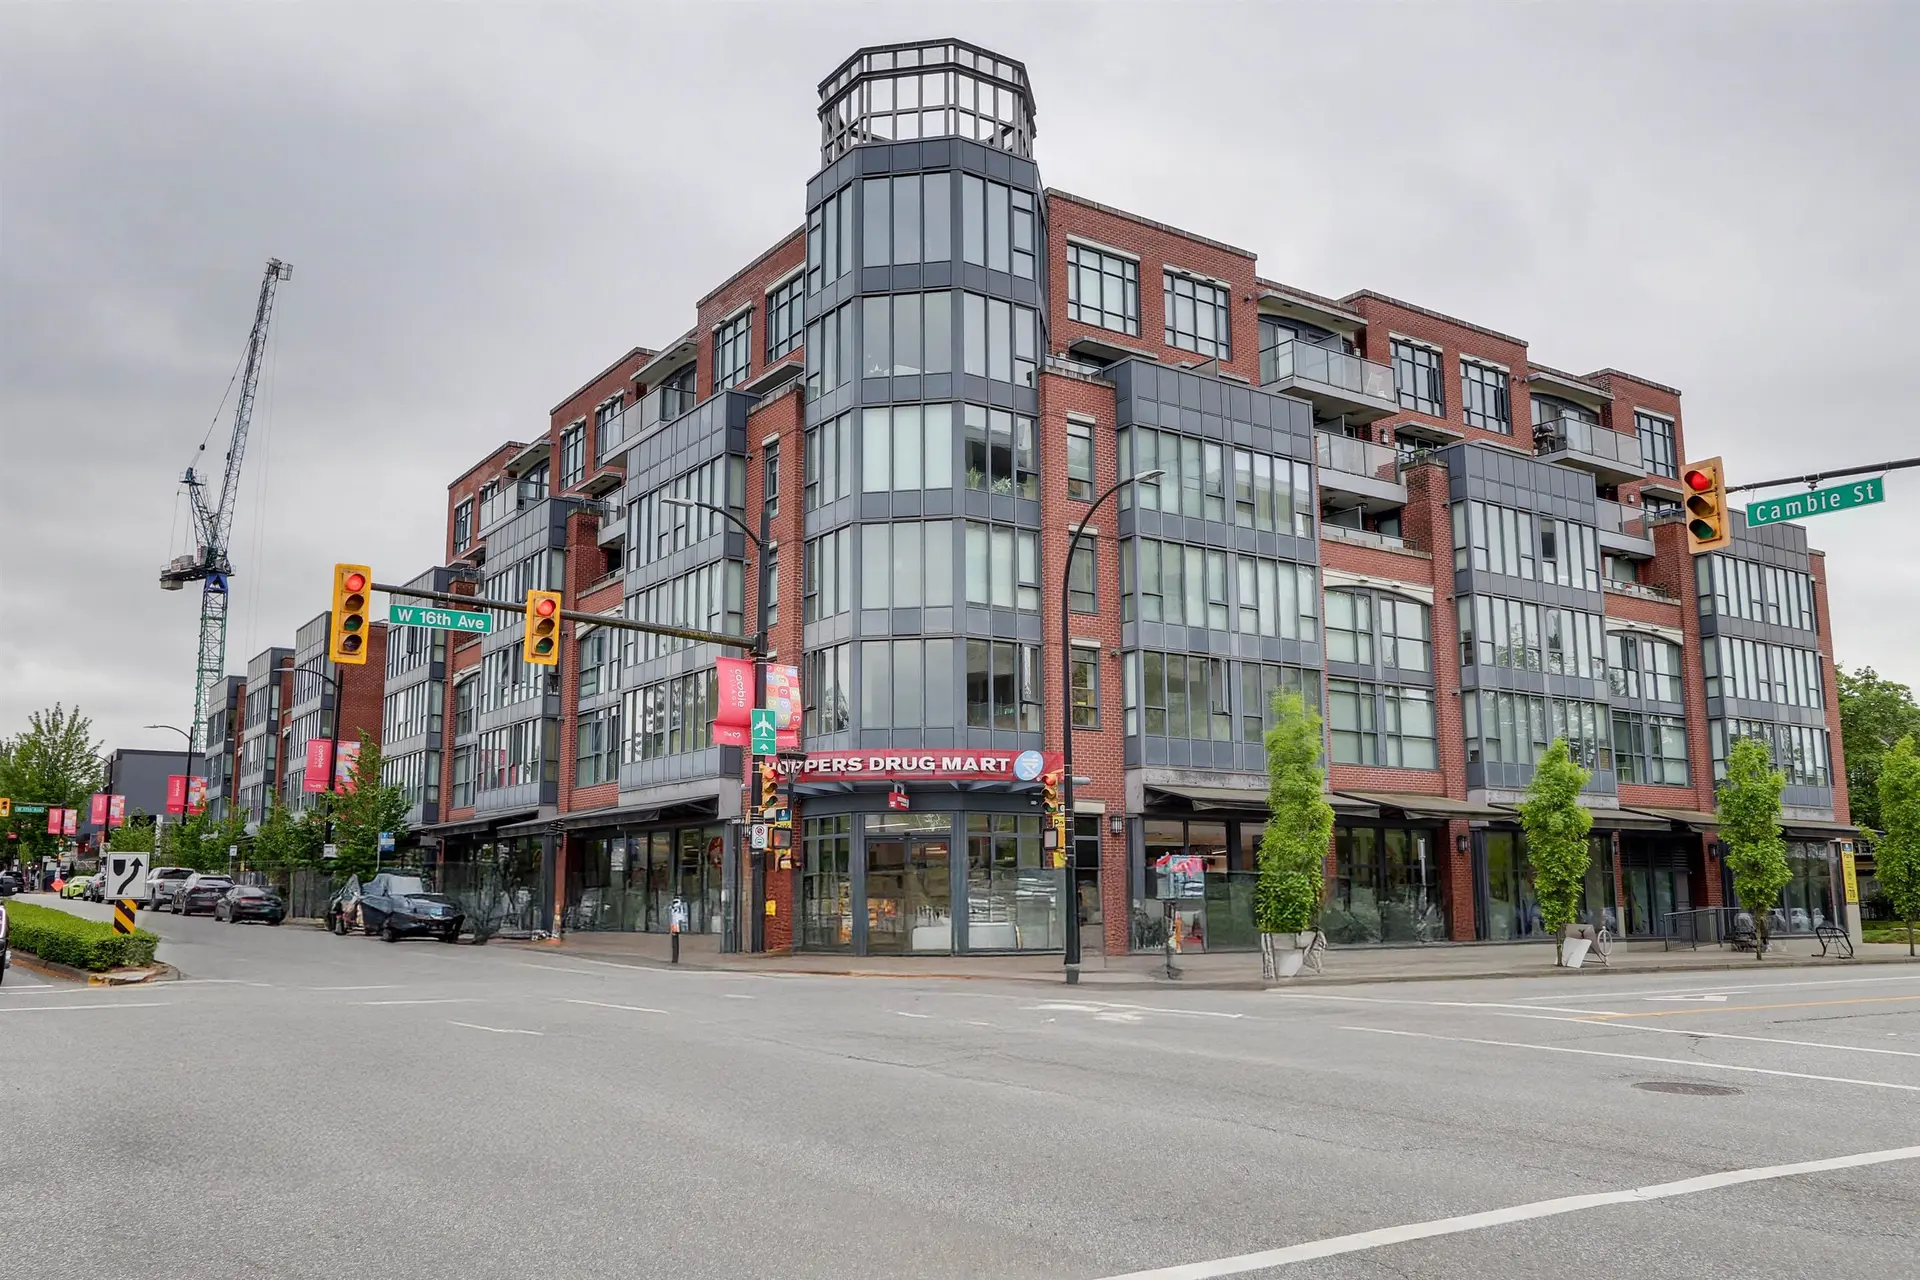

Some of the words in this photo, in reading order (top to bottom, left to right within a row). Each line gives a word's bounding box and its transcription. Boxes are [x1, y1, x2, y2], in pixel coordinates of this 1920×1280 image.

[1756, 492, 1841, 522] Cambie
[1853, 483, 1875, 502] St
[397, 608, 413, 622] W
[419, 610, 451, 626] 16th
[457, 614, 485, 629] Ave
[869, 756, 936, 772] DRUG
[942, 756, 1011, 772] MART
